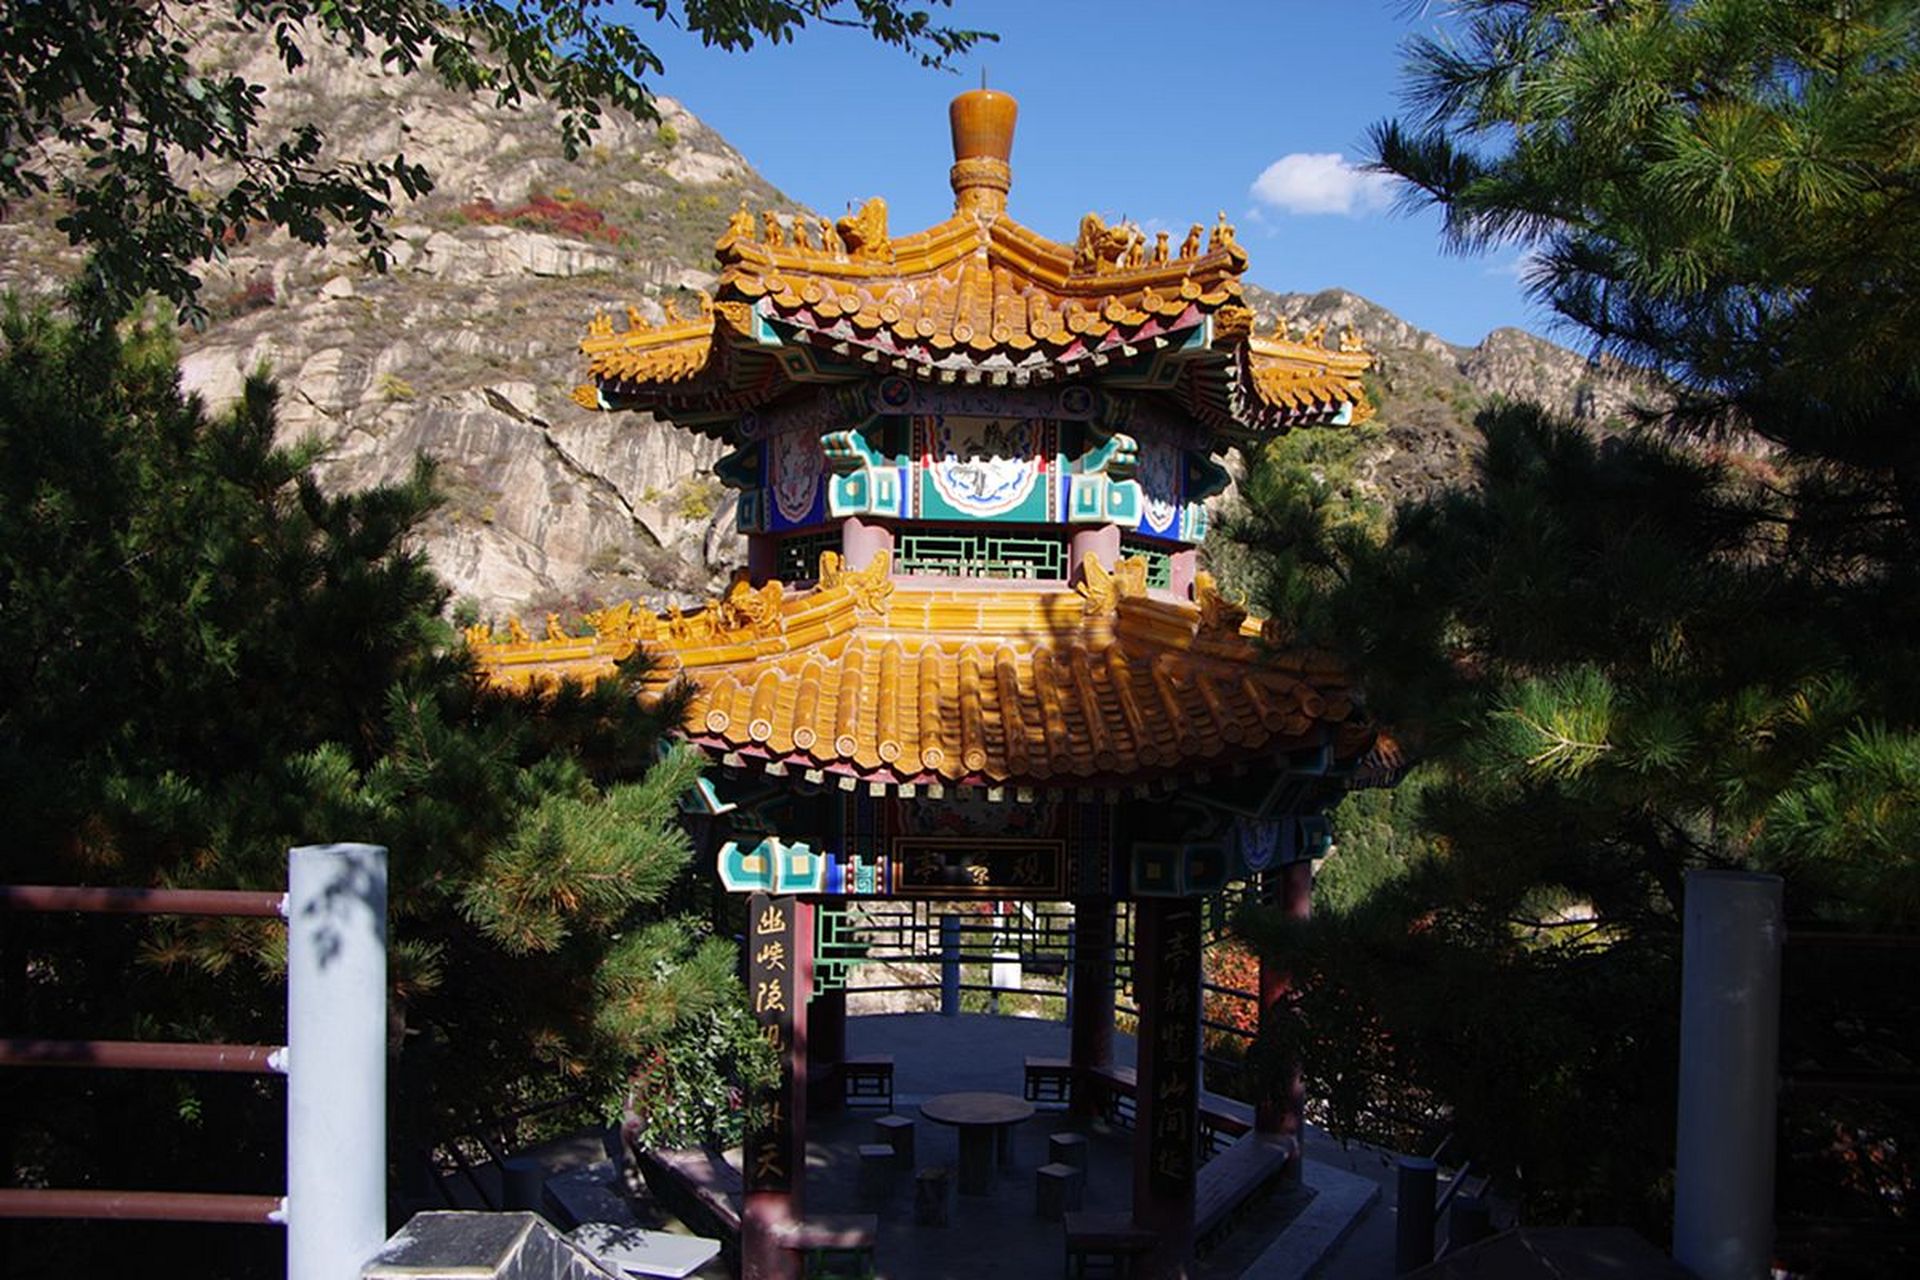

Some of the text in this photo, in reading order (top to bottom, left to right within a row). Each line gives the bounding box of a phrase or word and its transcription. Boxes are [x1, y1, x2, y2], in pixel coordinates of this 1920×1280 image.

[756, 905, 787, 1178] 幽峡隐现外天
